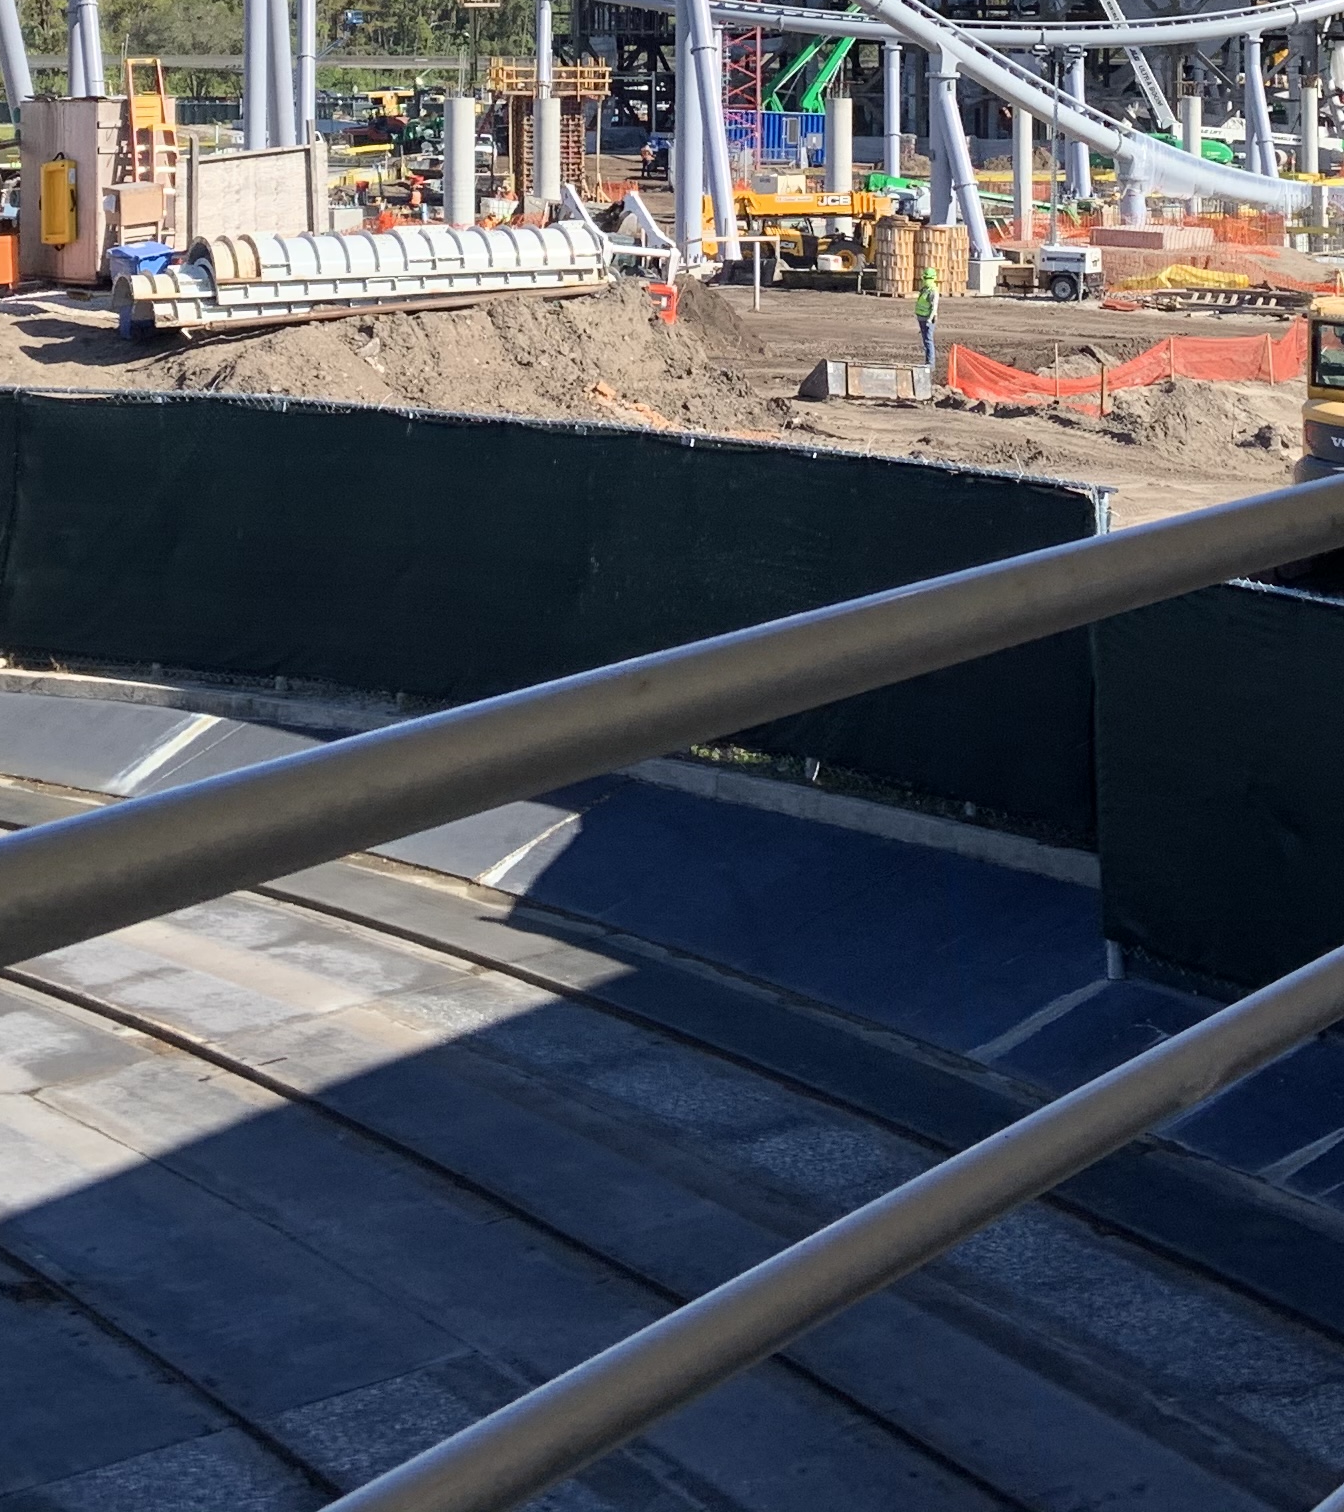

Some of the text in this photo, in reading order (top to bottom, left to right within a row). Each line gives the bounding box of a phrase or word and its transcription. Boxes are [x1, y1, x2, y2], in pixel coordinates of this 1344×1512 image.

[1138, 65, 1152, 86] ULTRA
[1148, 86, 1164, 107] BOOM
[817, 195, 851, 206] JCB
